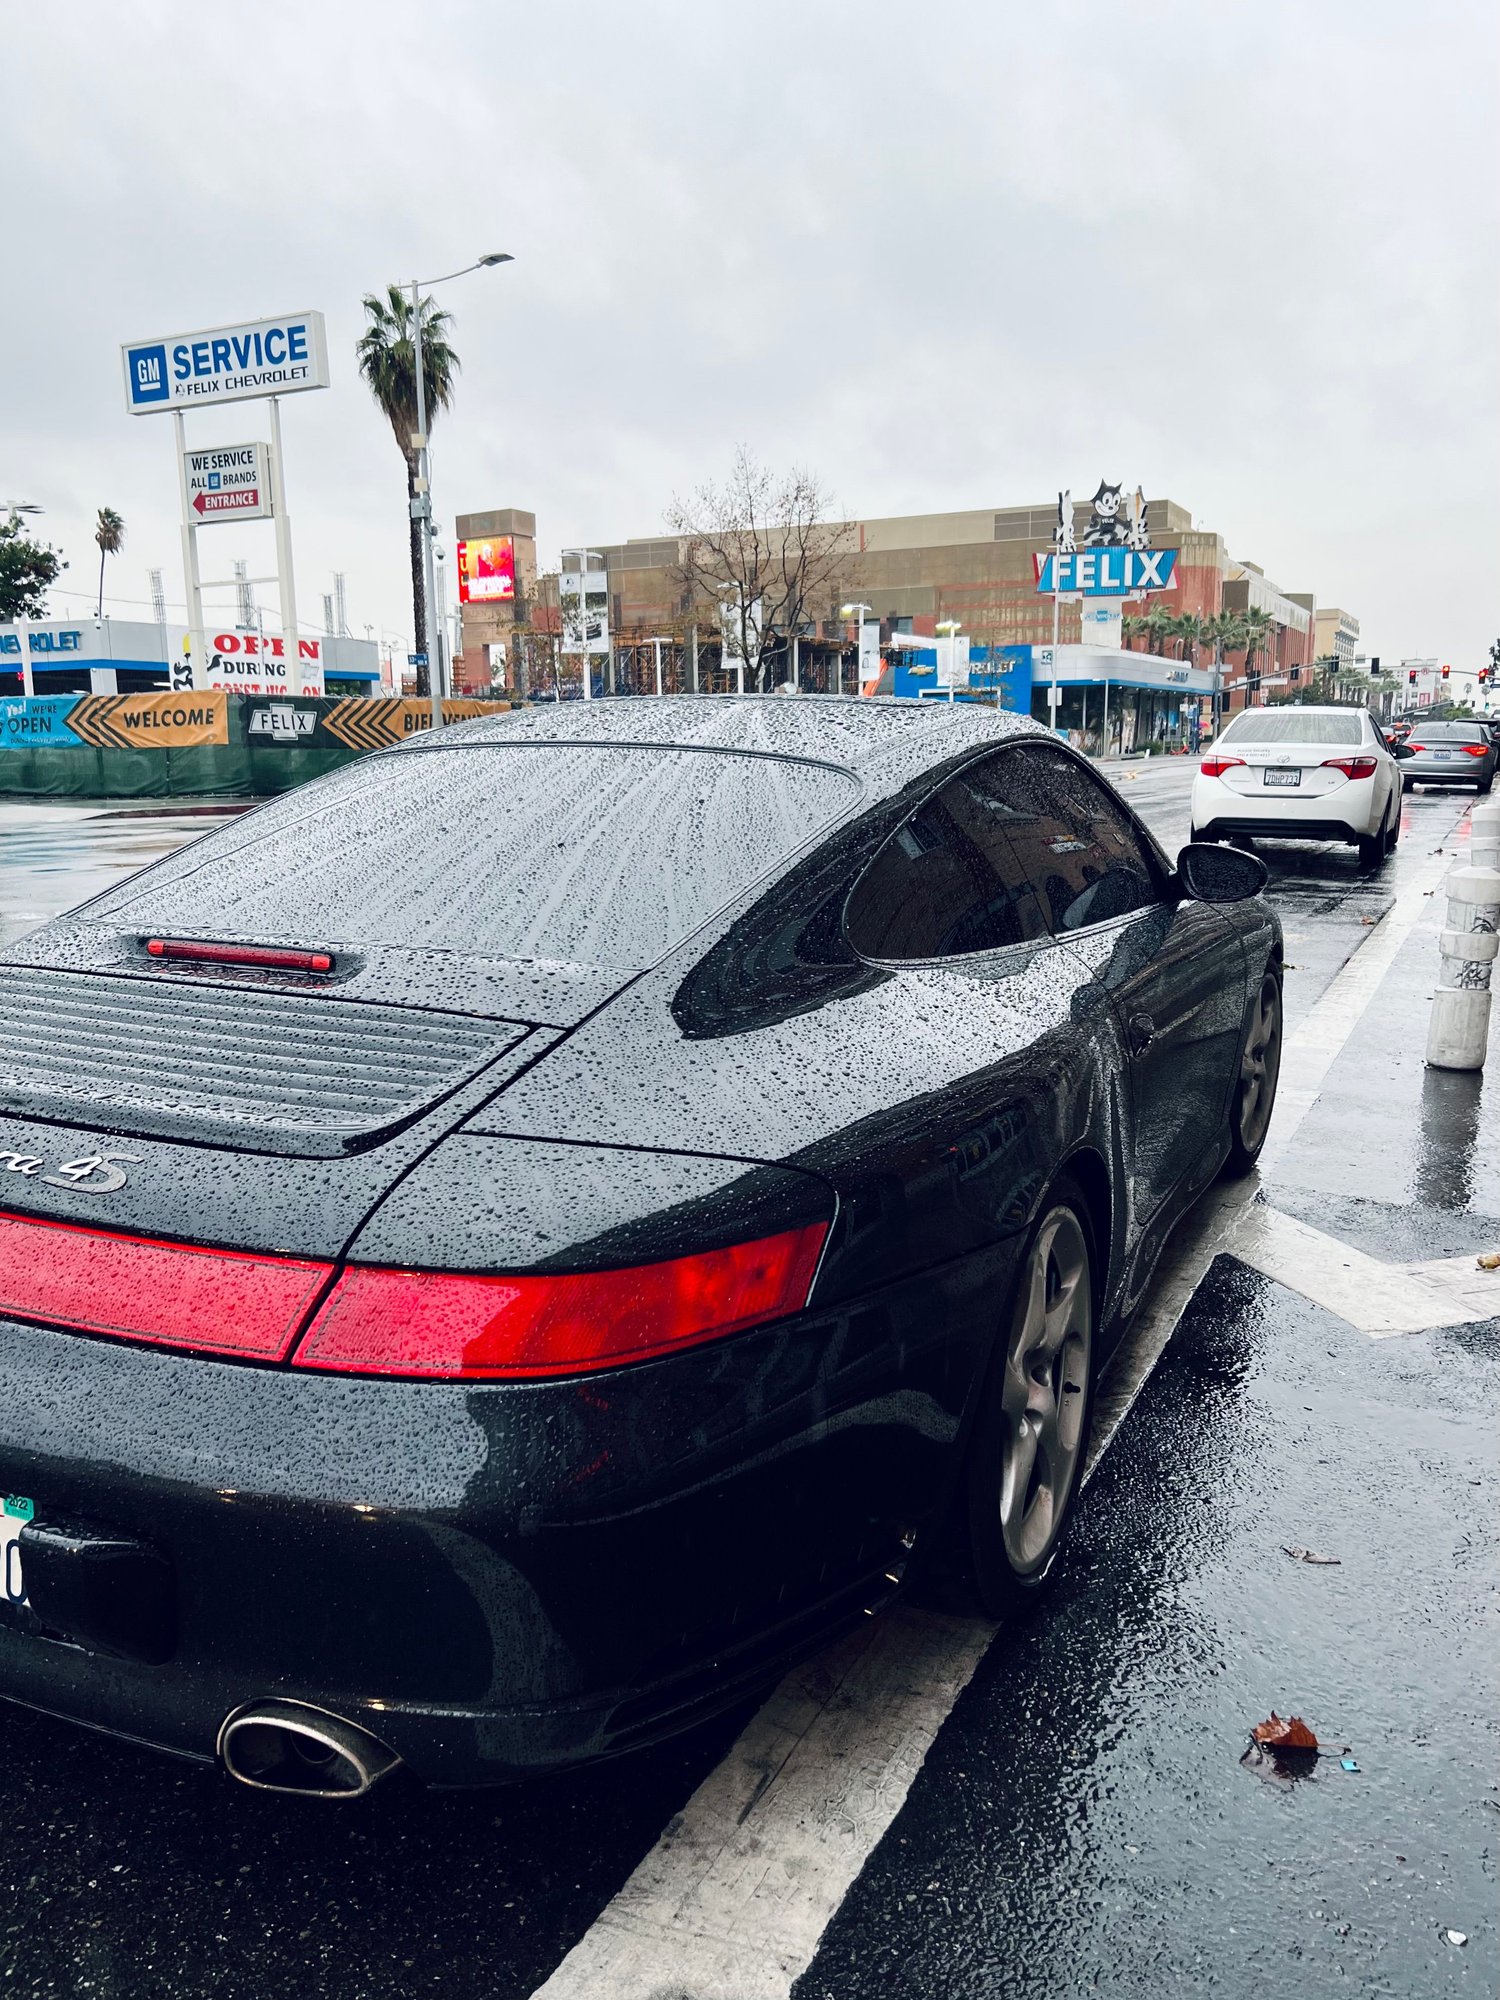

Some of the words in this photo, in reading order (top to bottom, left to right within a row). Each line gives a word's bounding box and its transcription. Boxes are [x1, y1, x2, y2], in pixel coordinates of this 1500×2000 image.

[173, 324, 308, 380] SERVICE
[137, 357, 160, 384] GM
[187, 380, 219, 395] FELIX
[225, 366, 308, 390] CHEVROLET
[191, 457, 209, 471] WE
[211, 450, 254, 469] SERVICE
[191, 477, 207, 488] ALL
[223, 471, 257, 485] BRANDS
[205, 492, 254, 509] ENTRANCE
[1051, 552, 1165, 589] FELIX
[213, 634, 320, 659] OPEN
[7, 699, 26, 718] Yes!
[31, 704, 57, 714] WE'RE
[124, 708, 214, 729] WELCOME
[8, 716, 52, 734] OPEN
[261, 714, 307, 731] FELIX
